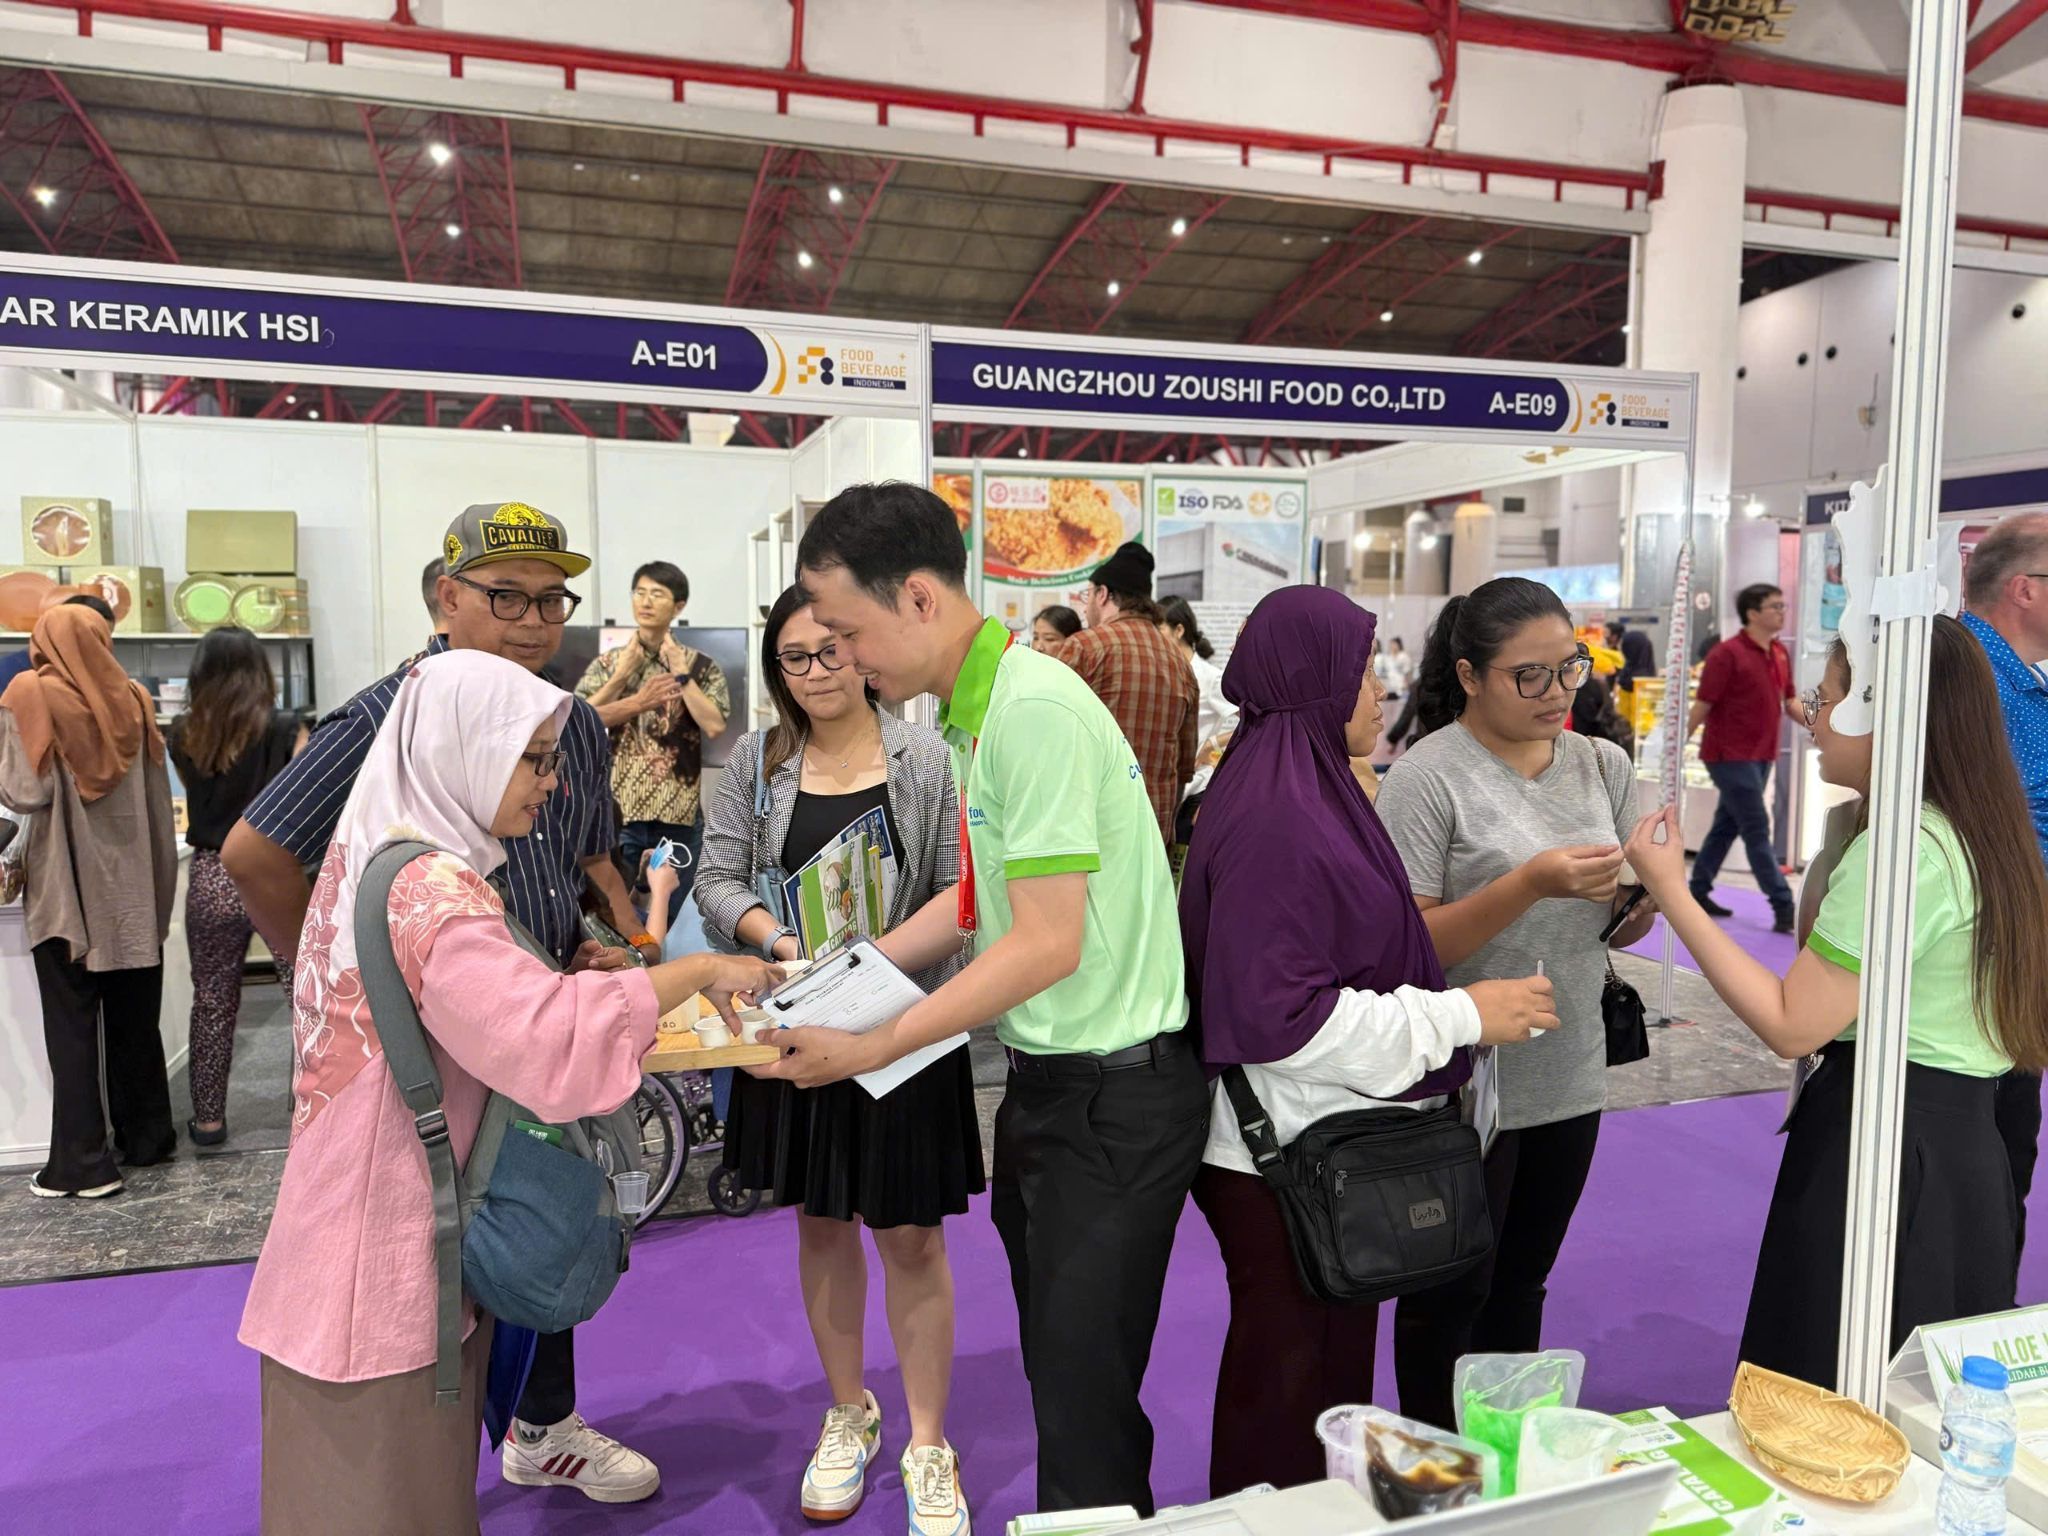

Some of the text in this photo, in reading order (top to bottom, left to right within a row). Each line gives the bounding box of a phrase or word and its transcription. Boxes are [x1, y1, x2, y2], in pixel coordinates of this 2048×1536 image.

[0, 297, 320, 343] AR KERAMIK HSI
[632, 340, 717, 370] A-E01
[841, 348, 874, 362] FOOD
[841, 362, 907, 378] BEVERAGE
[853, 379, 895, 389] INDONESIA
[972, 363, 1446, 413] GUANGZHOU ZOUSHI FOOD CO.,LTD
[1489, 392, 1557, 418] A-E09
[1622, 394, 1647, 405] FOOD
[1621, 406, 1670, 418] BEVERAGE
[1178, 495, 1209, 509] ISO
[1212, 495, 1244, 510] FDA
[1825, 499, 1850, 514] KIT
[1992, 1335, 2043, 1365] ALOE
[2007, 1367, 2038, 1382] LIDAH
